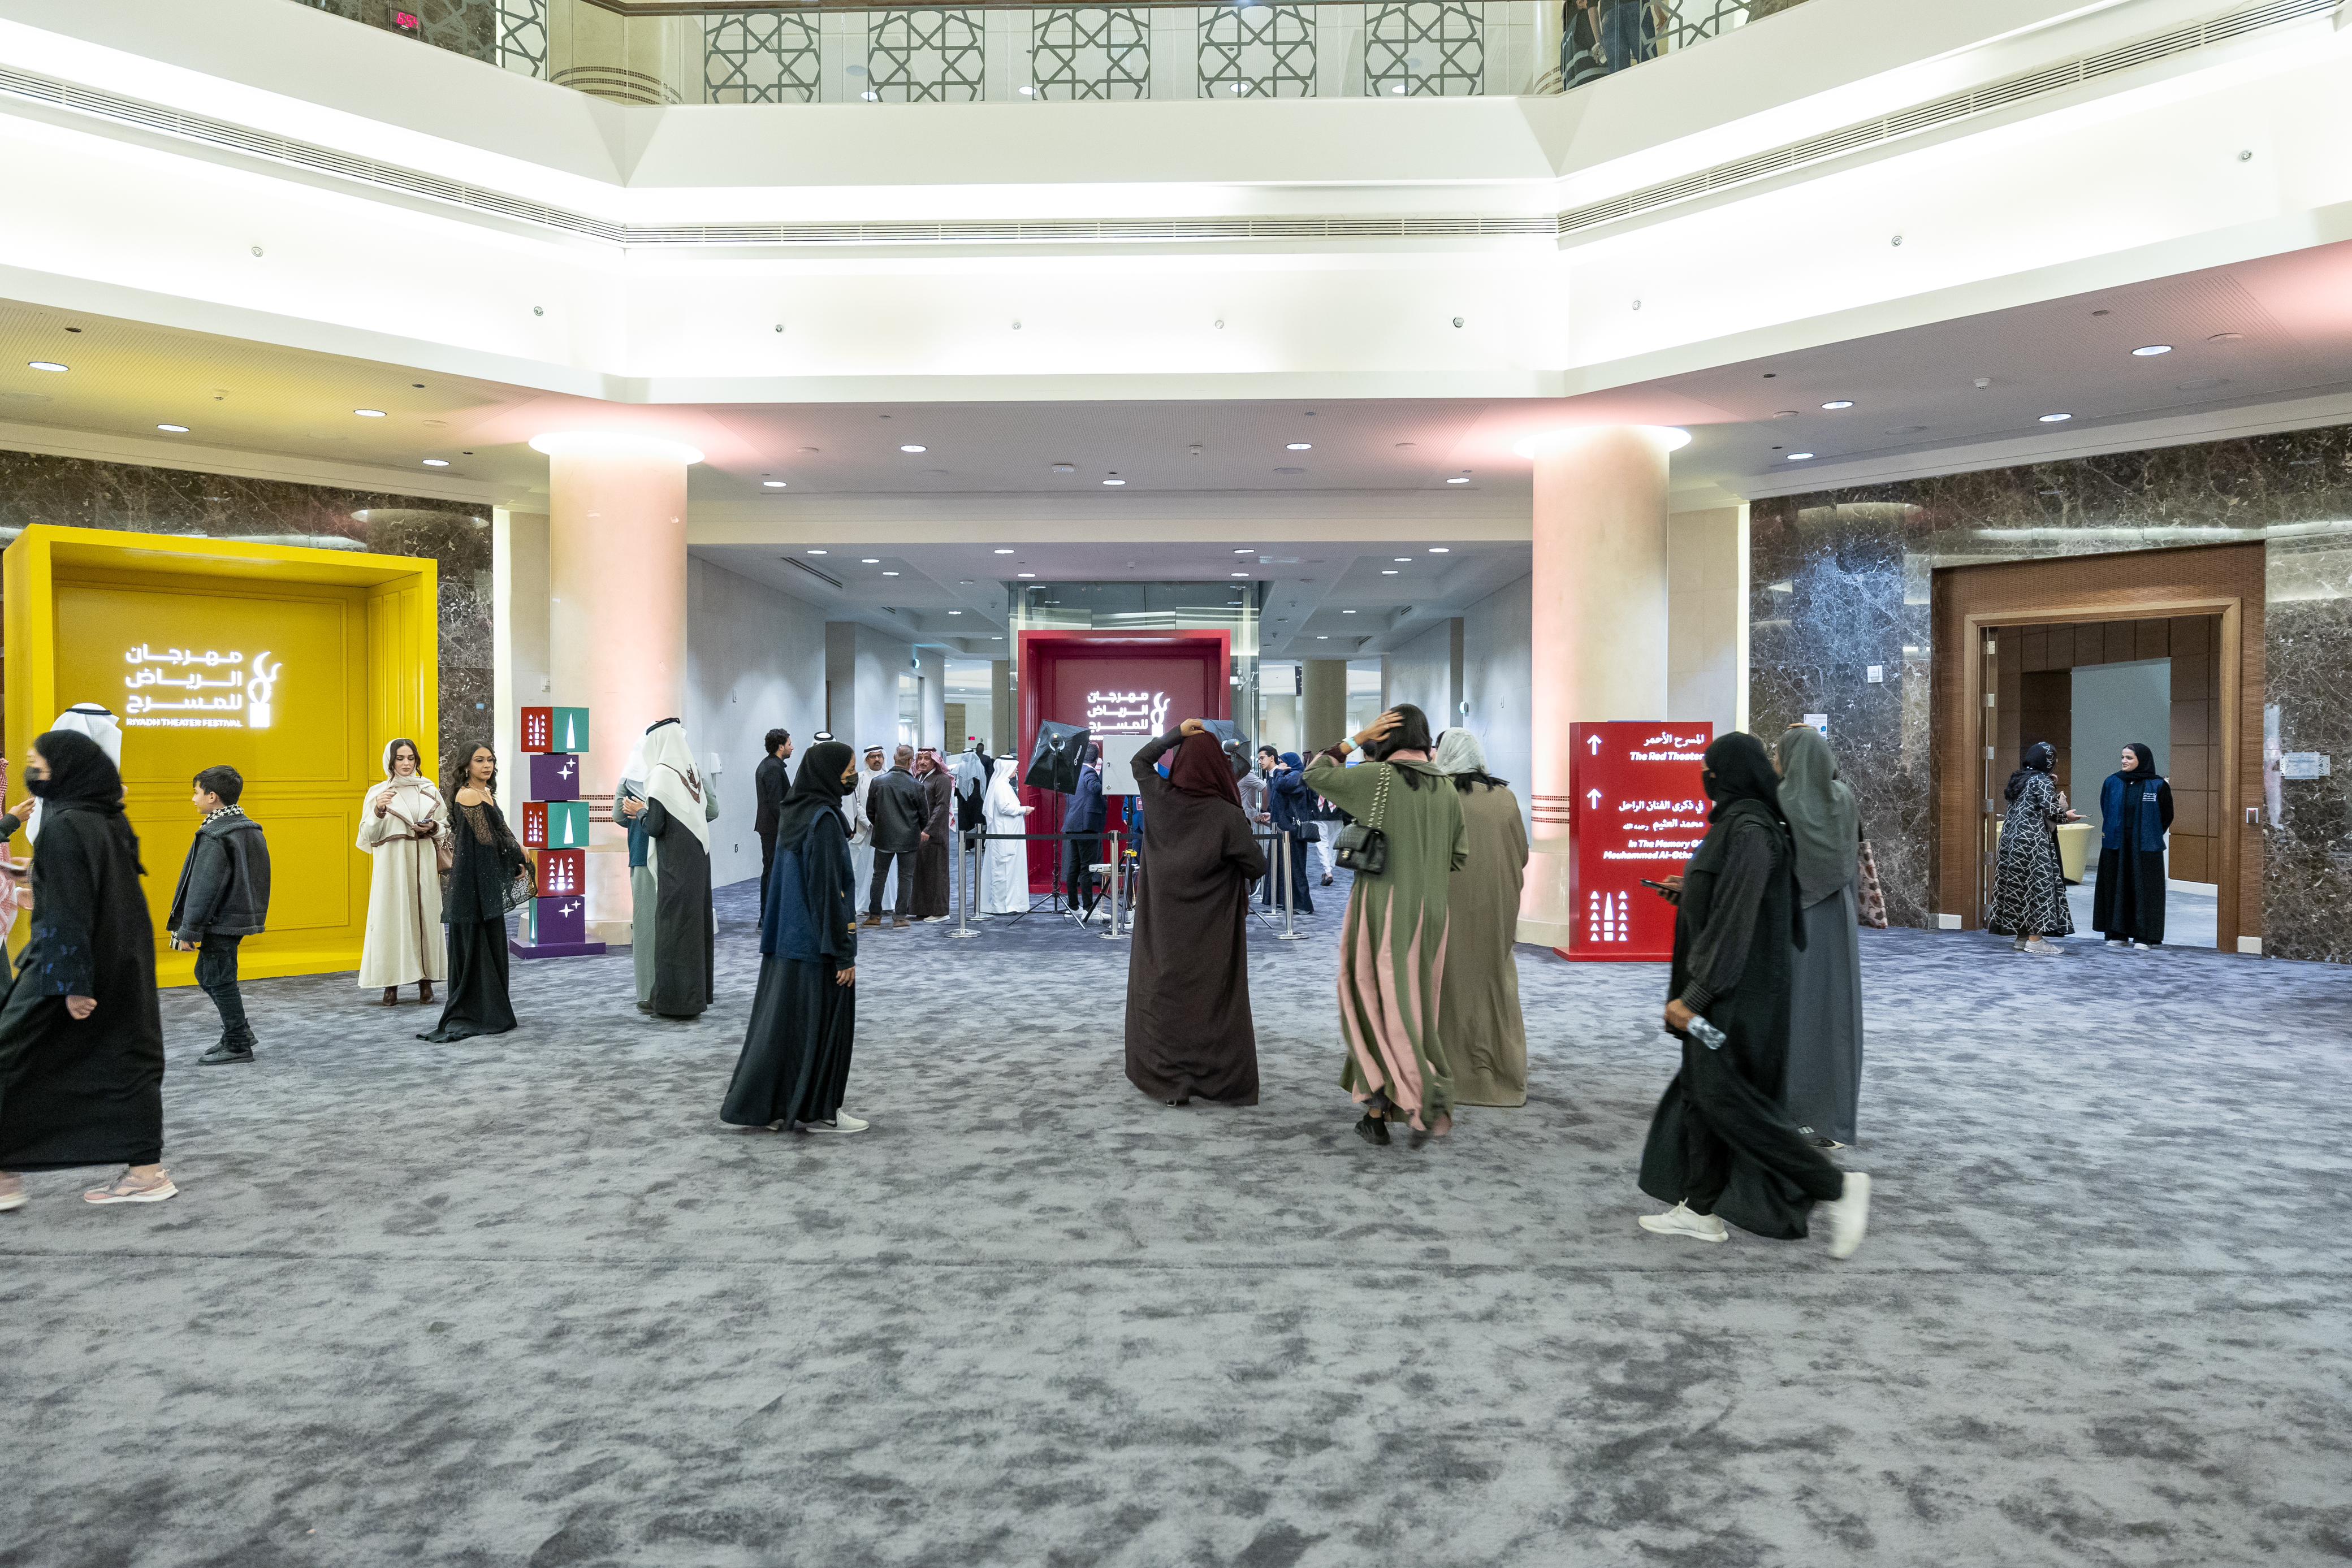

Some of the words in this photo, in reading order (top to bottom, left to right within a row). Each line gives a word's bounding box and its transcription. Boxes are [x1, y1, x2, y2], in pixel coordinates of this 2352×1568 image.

[126, 643, 243, 666] مهرجان
[126, 668, 242, 690] الرياض
[126, 694, 242, 713] للمسرح
[1087, 691, 1149, 703] مهرجان
[1087, 704, 1148, 717] الرياض
[126, 717, 161, 727] RIYADH
[161, 718, 202, 727] THEATER
[202, 718, 243, 728] FESTIVAL
[1088, 718, 1148, 733] للمسرح
[1643, 731, 1672, 746] الأحمر
[1674, 734, 1705, 748] المسرح
[1629, 751, 1648, 761] The
[1649, 751, 1667, 761] Red
[1668, 751, 1705, 761] Theater
[1619, 800, 1645, 812] الراحل
[1646, 800, 1670, 812] الفنان
[1672, 800, 1694, 812] ذكرى
[1695, 800, 1704, 814] في
[1628, 839, 1637, 848] In
[1638, 839, 1655, 848] The
[1655, 839, 1690, 850] Memory
